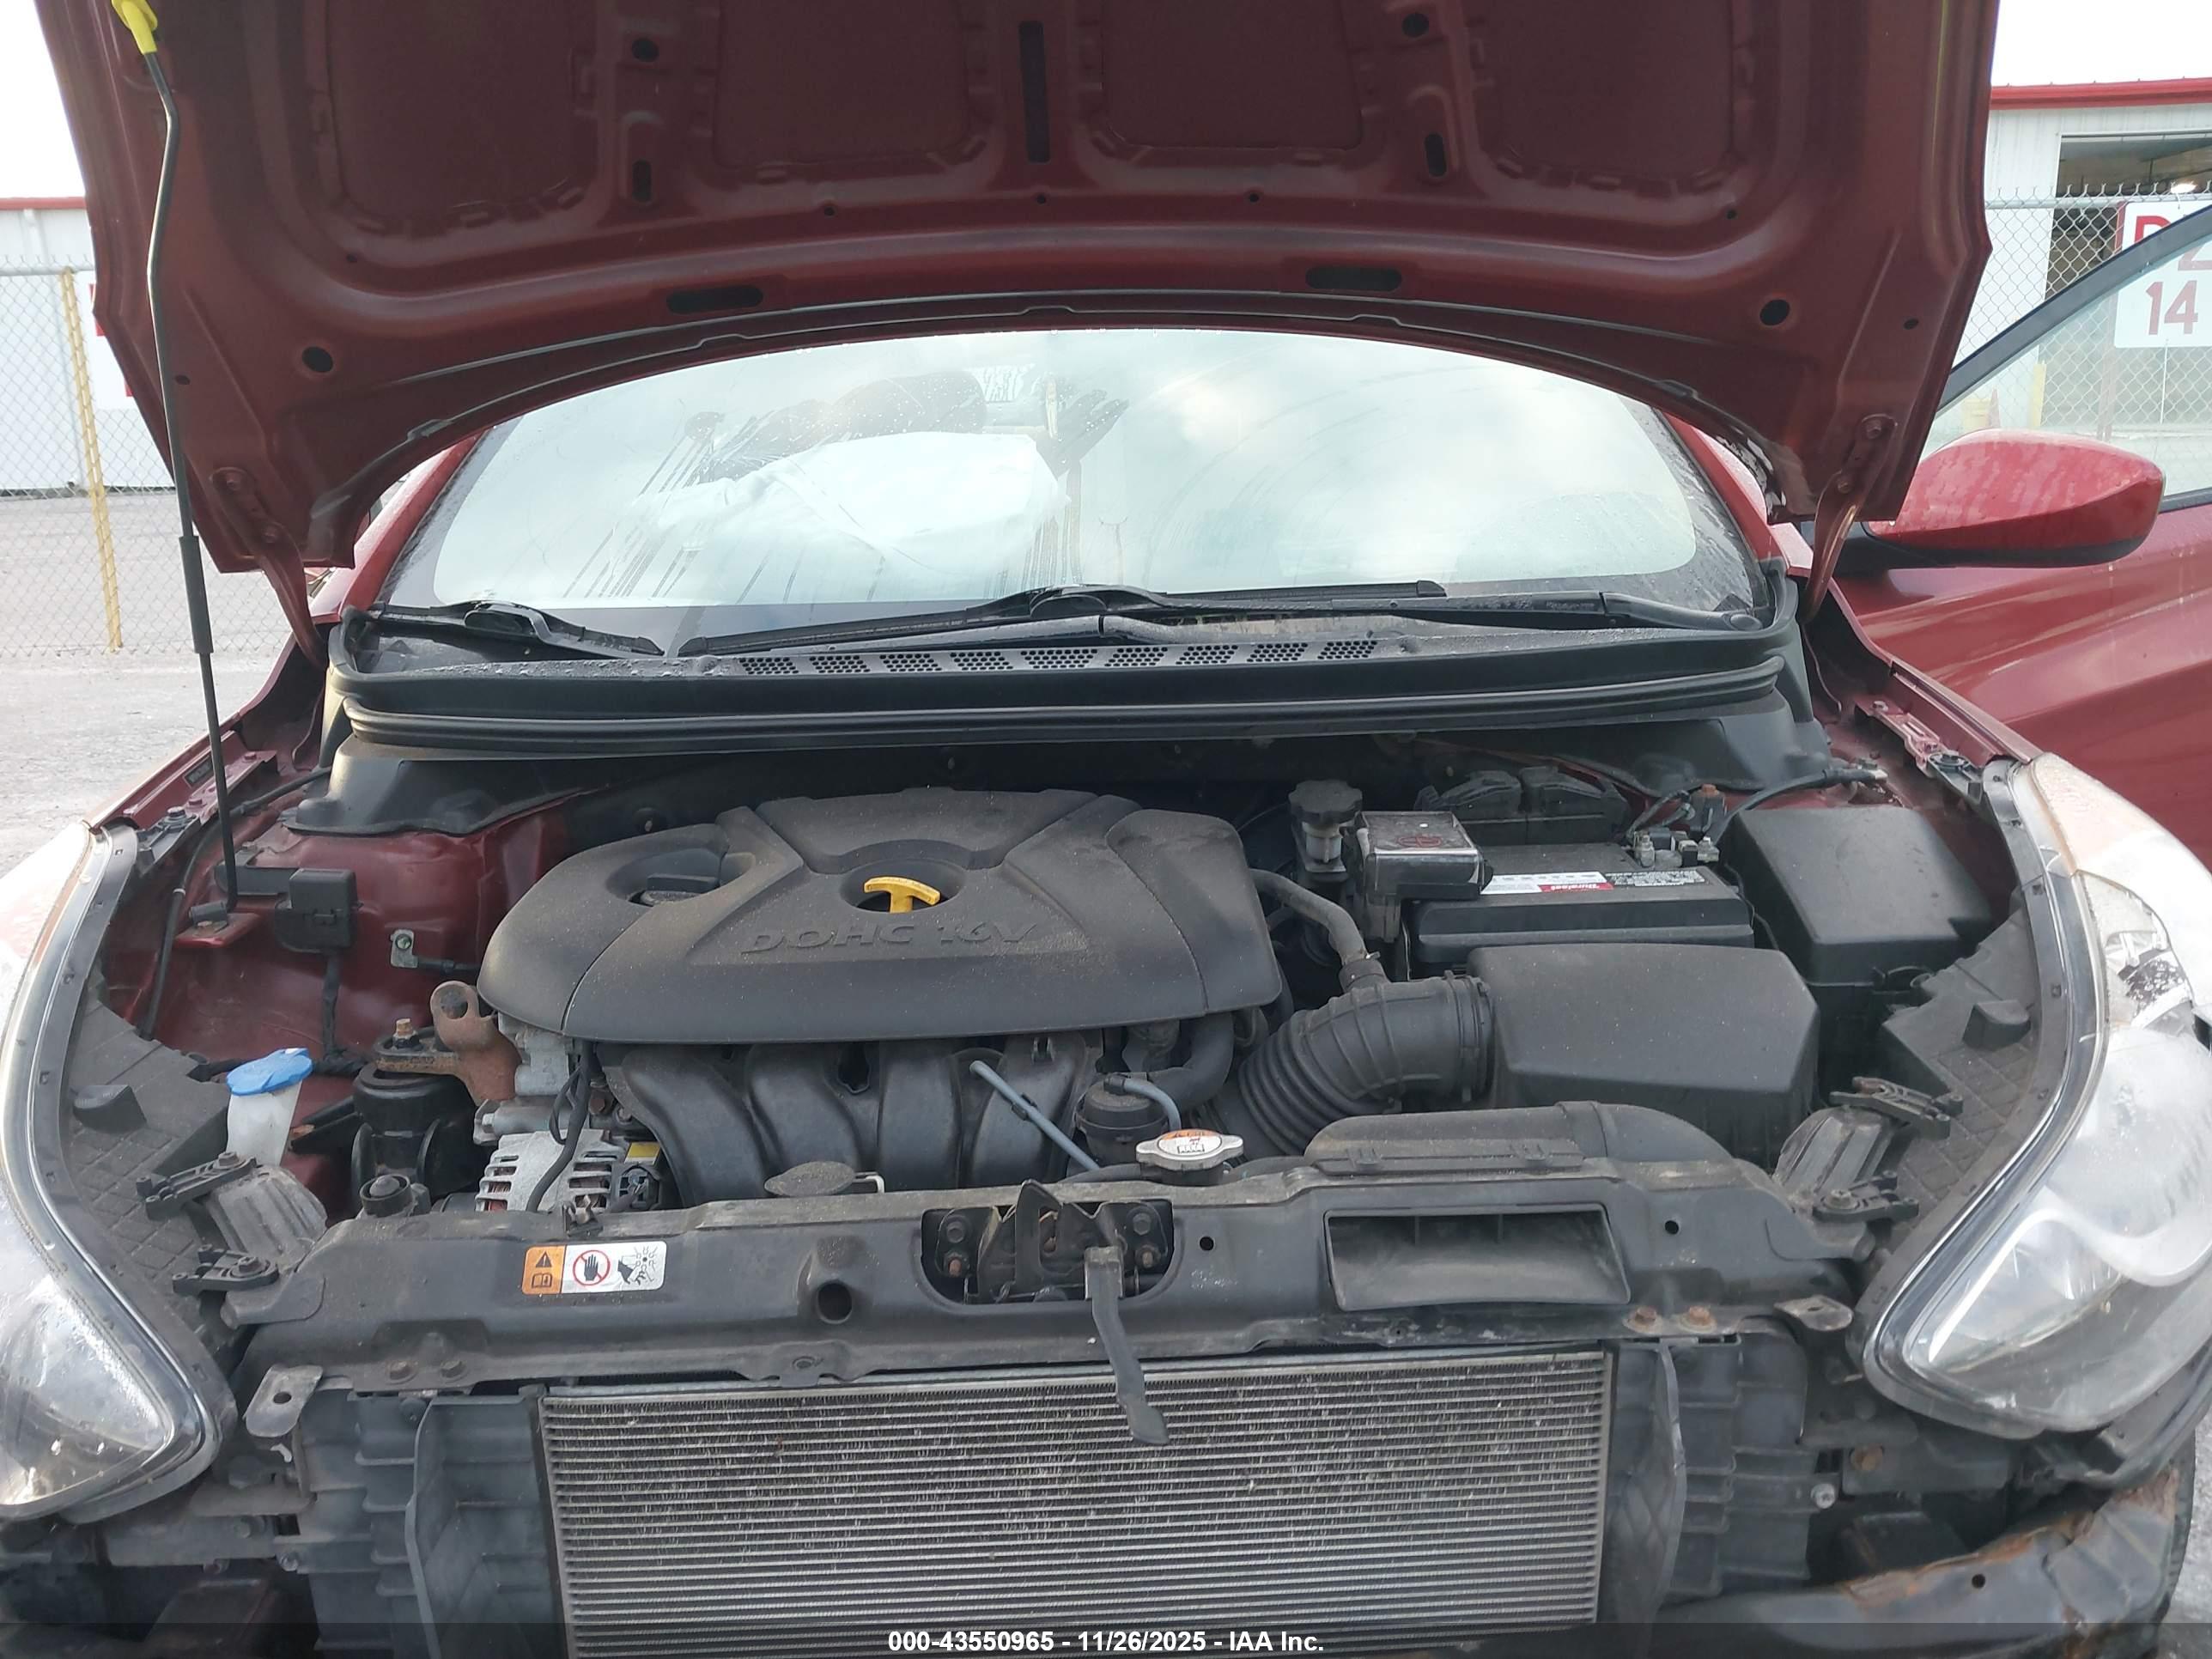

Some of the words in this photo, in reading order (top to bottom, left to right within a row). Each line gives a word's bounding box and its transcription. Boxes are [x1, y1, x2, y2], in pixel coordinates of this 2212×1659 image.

[2145, 280, 2198, 335] 14
[740, 921, 915, 955] DOHC
[937, 920, 1037, 943] 16V
